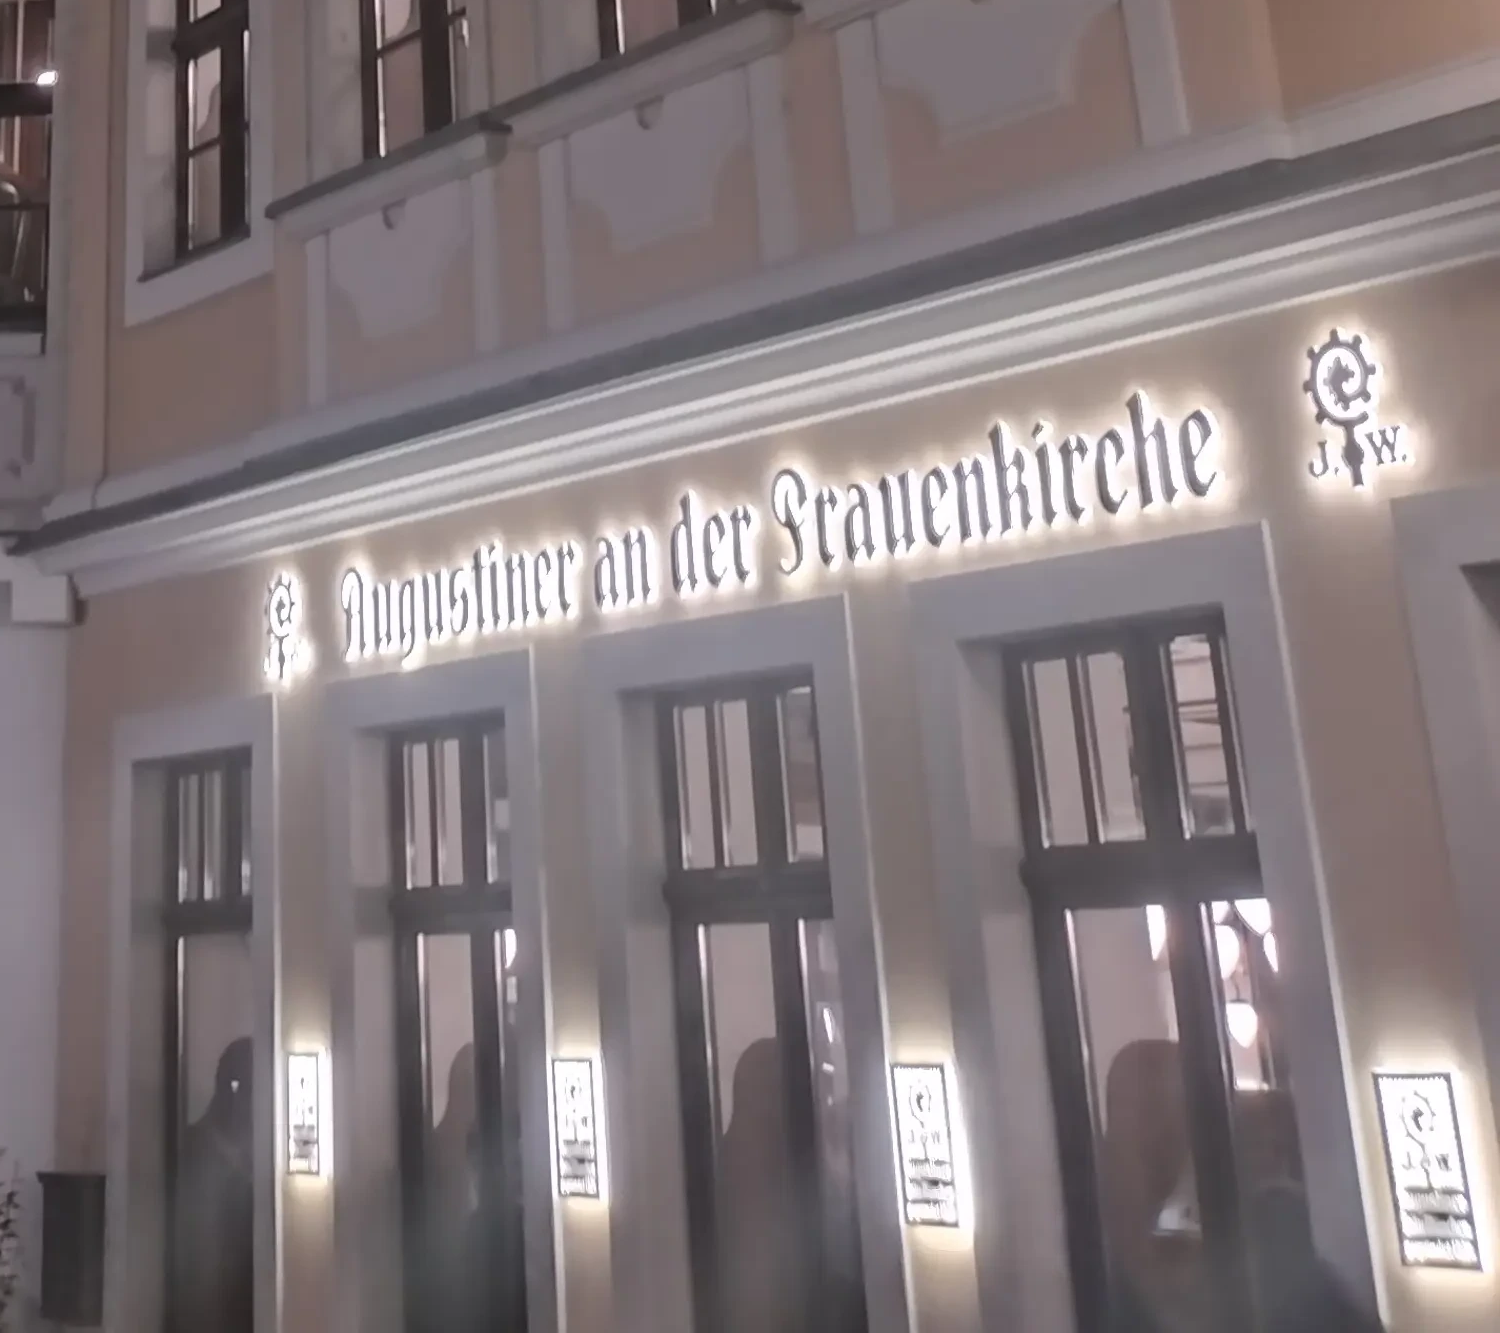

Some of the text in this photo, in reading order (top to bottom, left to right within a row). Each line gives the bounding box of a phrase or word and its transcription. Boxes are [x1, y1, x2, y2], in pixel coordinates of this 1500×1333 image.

[340, 389, 1219, 665] Augustiner an der Frauenkirche
